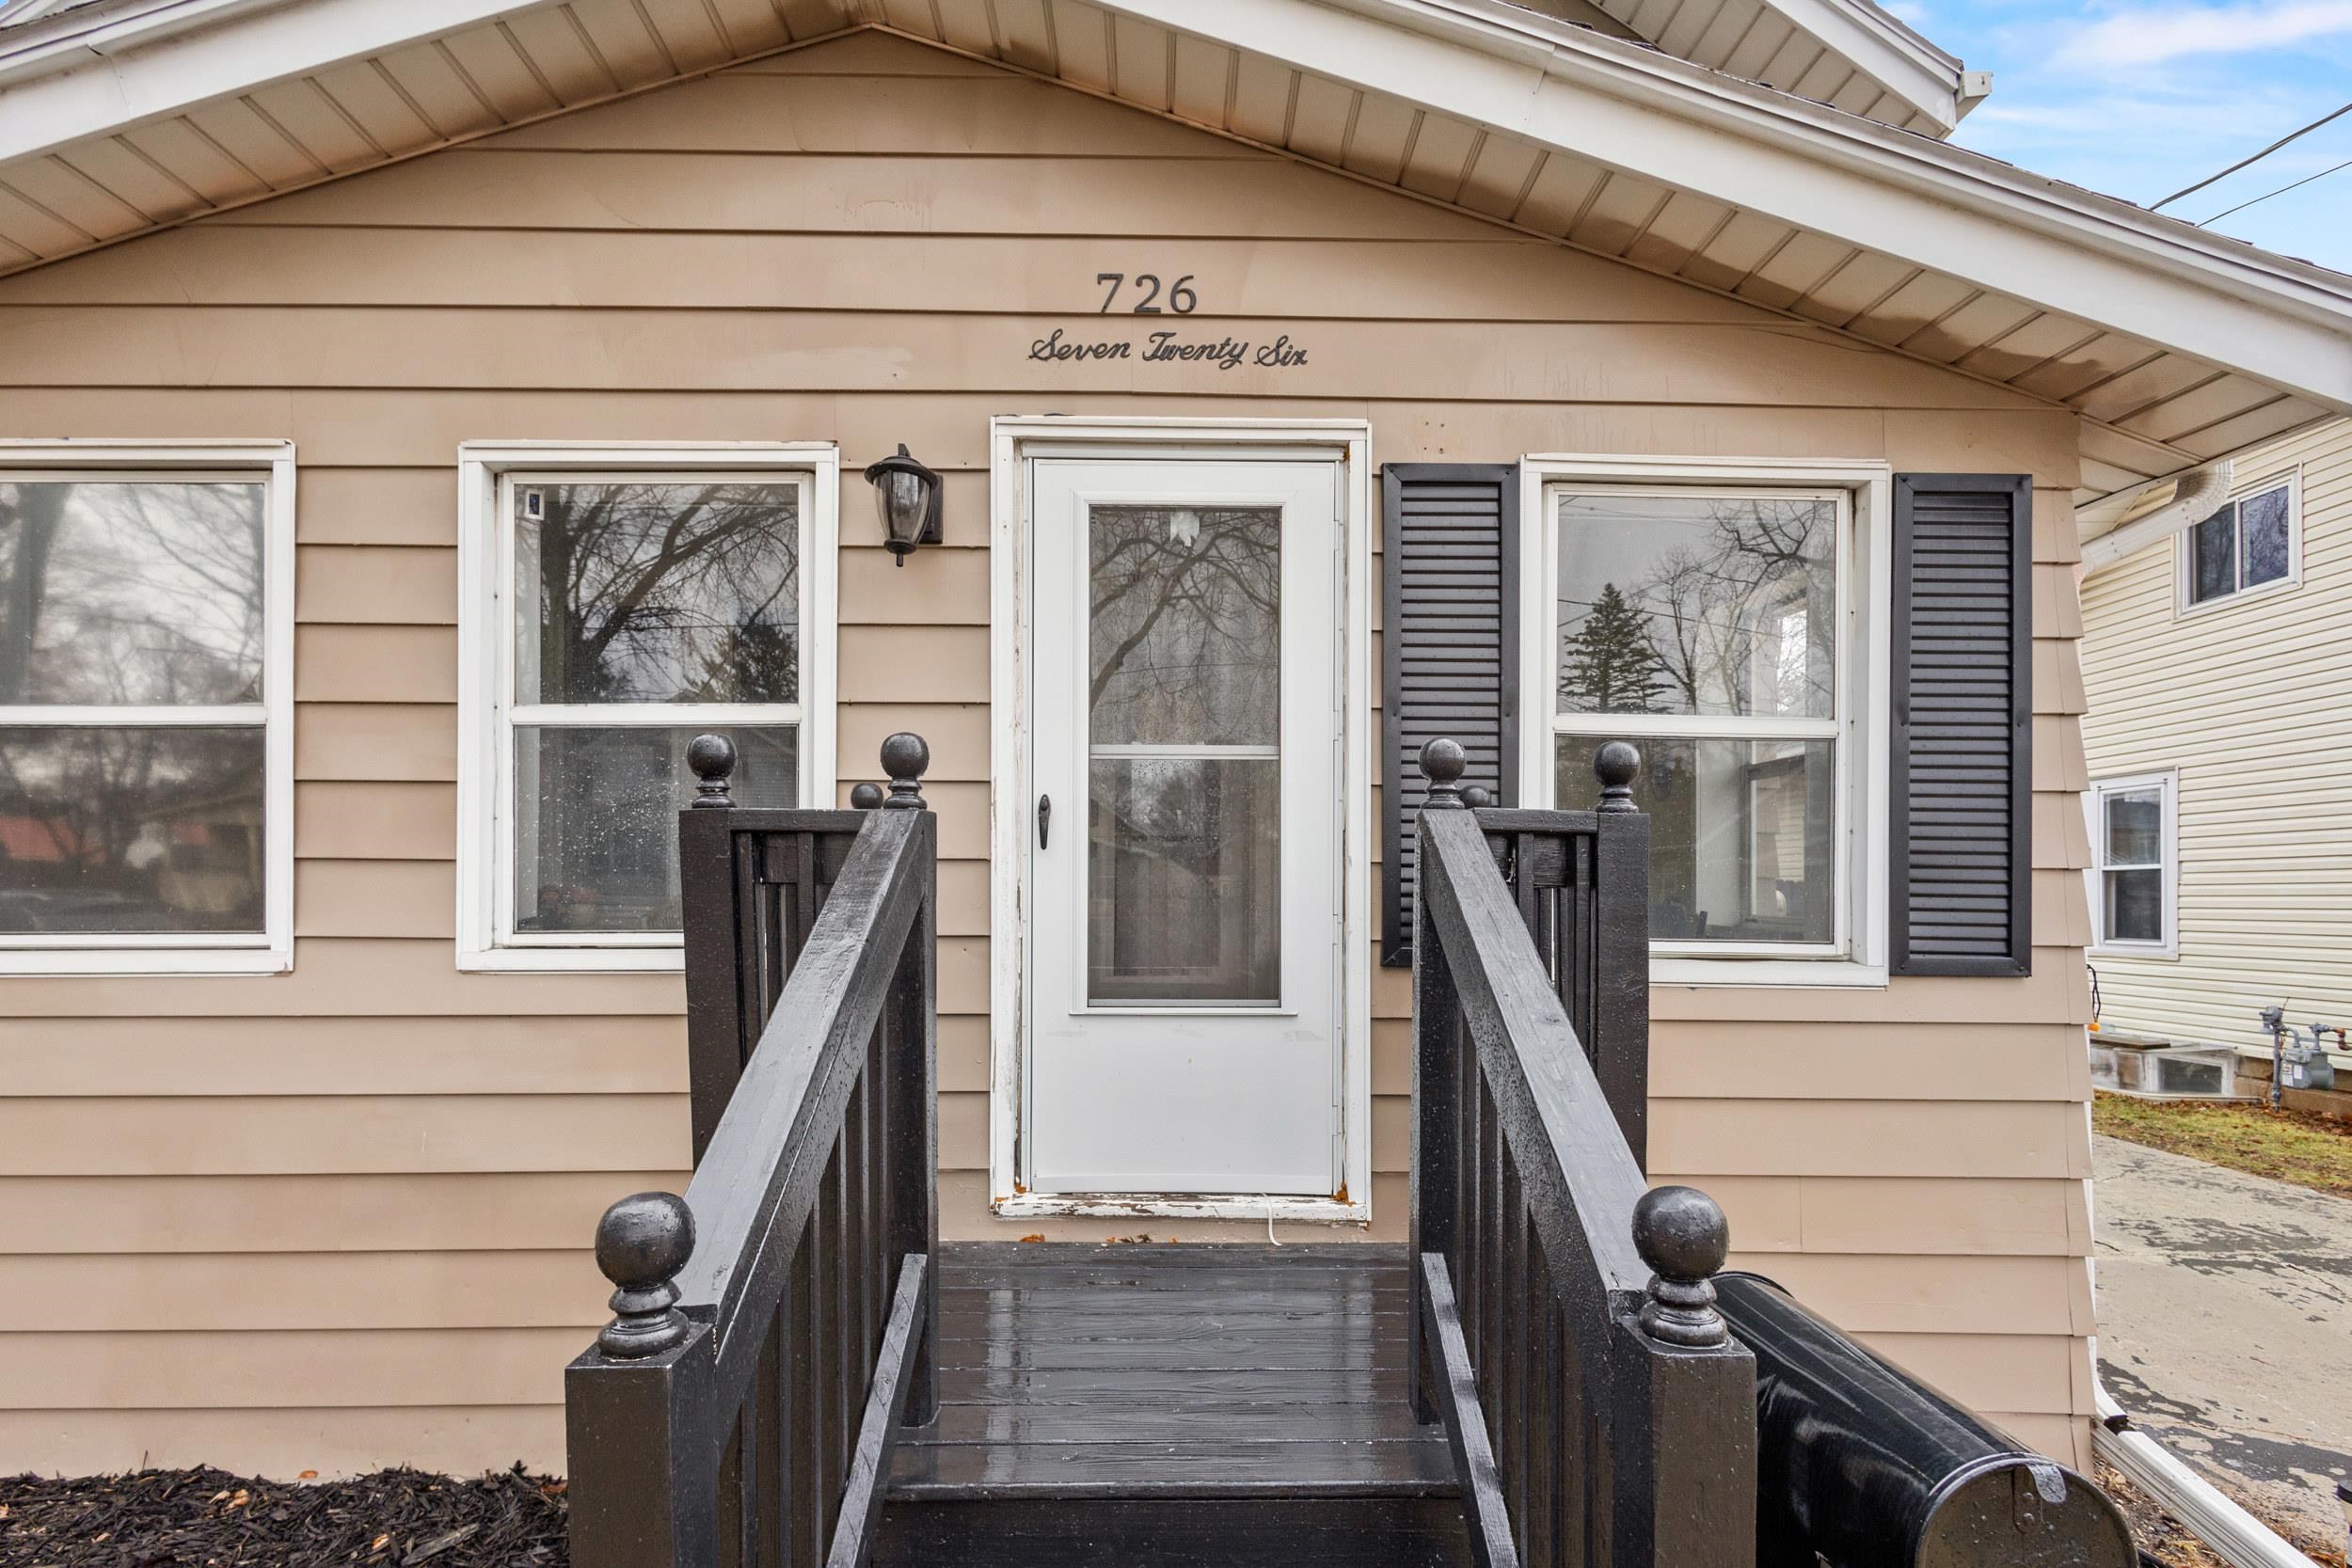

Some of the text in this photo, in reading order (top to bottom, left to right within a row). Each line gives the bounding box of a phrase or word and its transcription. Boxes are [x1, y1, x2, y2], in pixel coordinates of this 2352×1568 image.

[1097, 273, 1197, 314] 726
[1027, 328, 1309, 370] Seven Twenty Six
